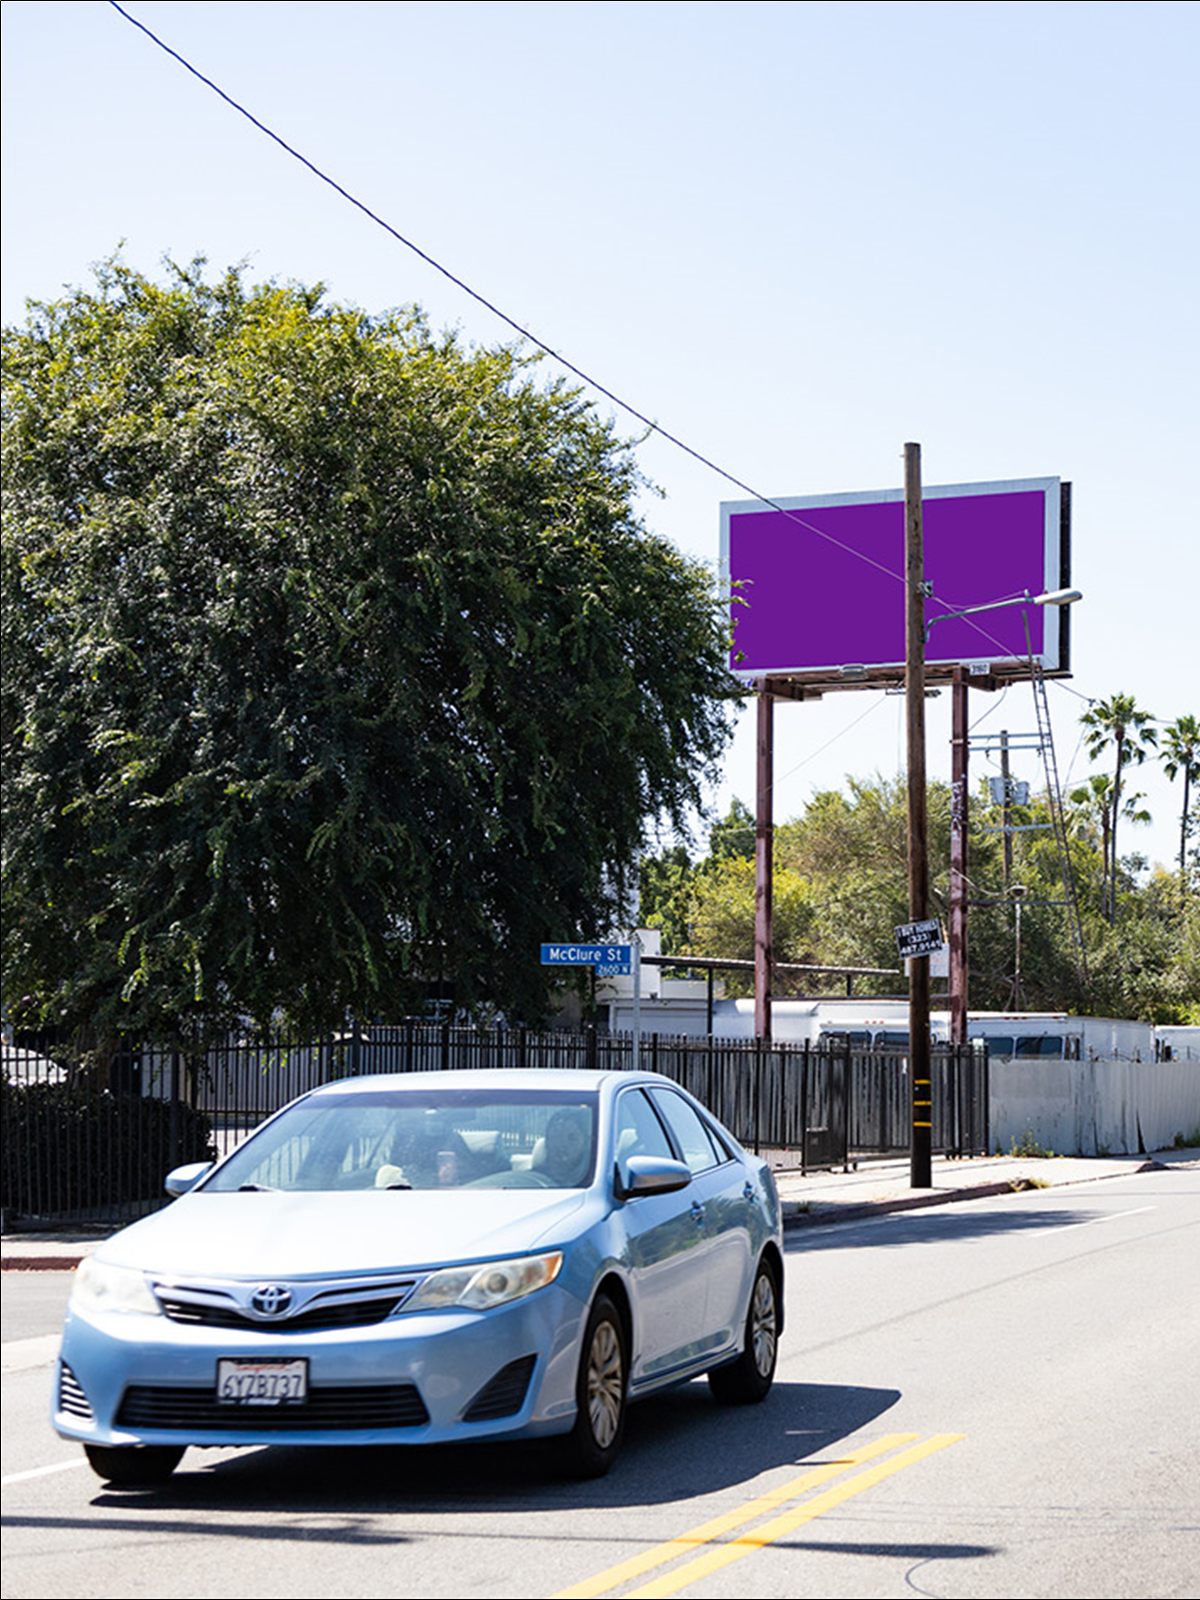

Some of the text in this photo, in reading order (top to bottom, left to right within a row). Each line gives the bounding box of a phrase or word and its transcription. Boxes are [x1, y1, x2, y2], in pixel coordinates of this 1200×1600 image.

[549, 947, 622, 961] McClure St
[598, 965, 620, 974] 2600
[223, 1374, 302, 1398] 6YZB737
